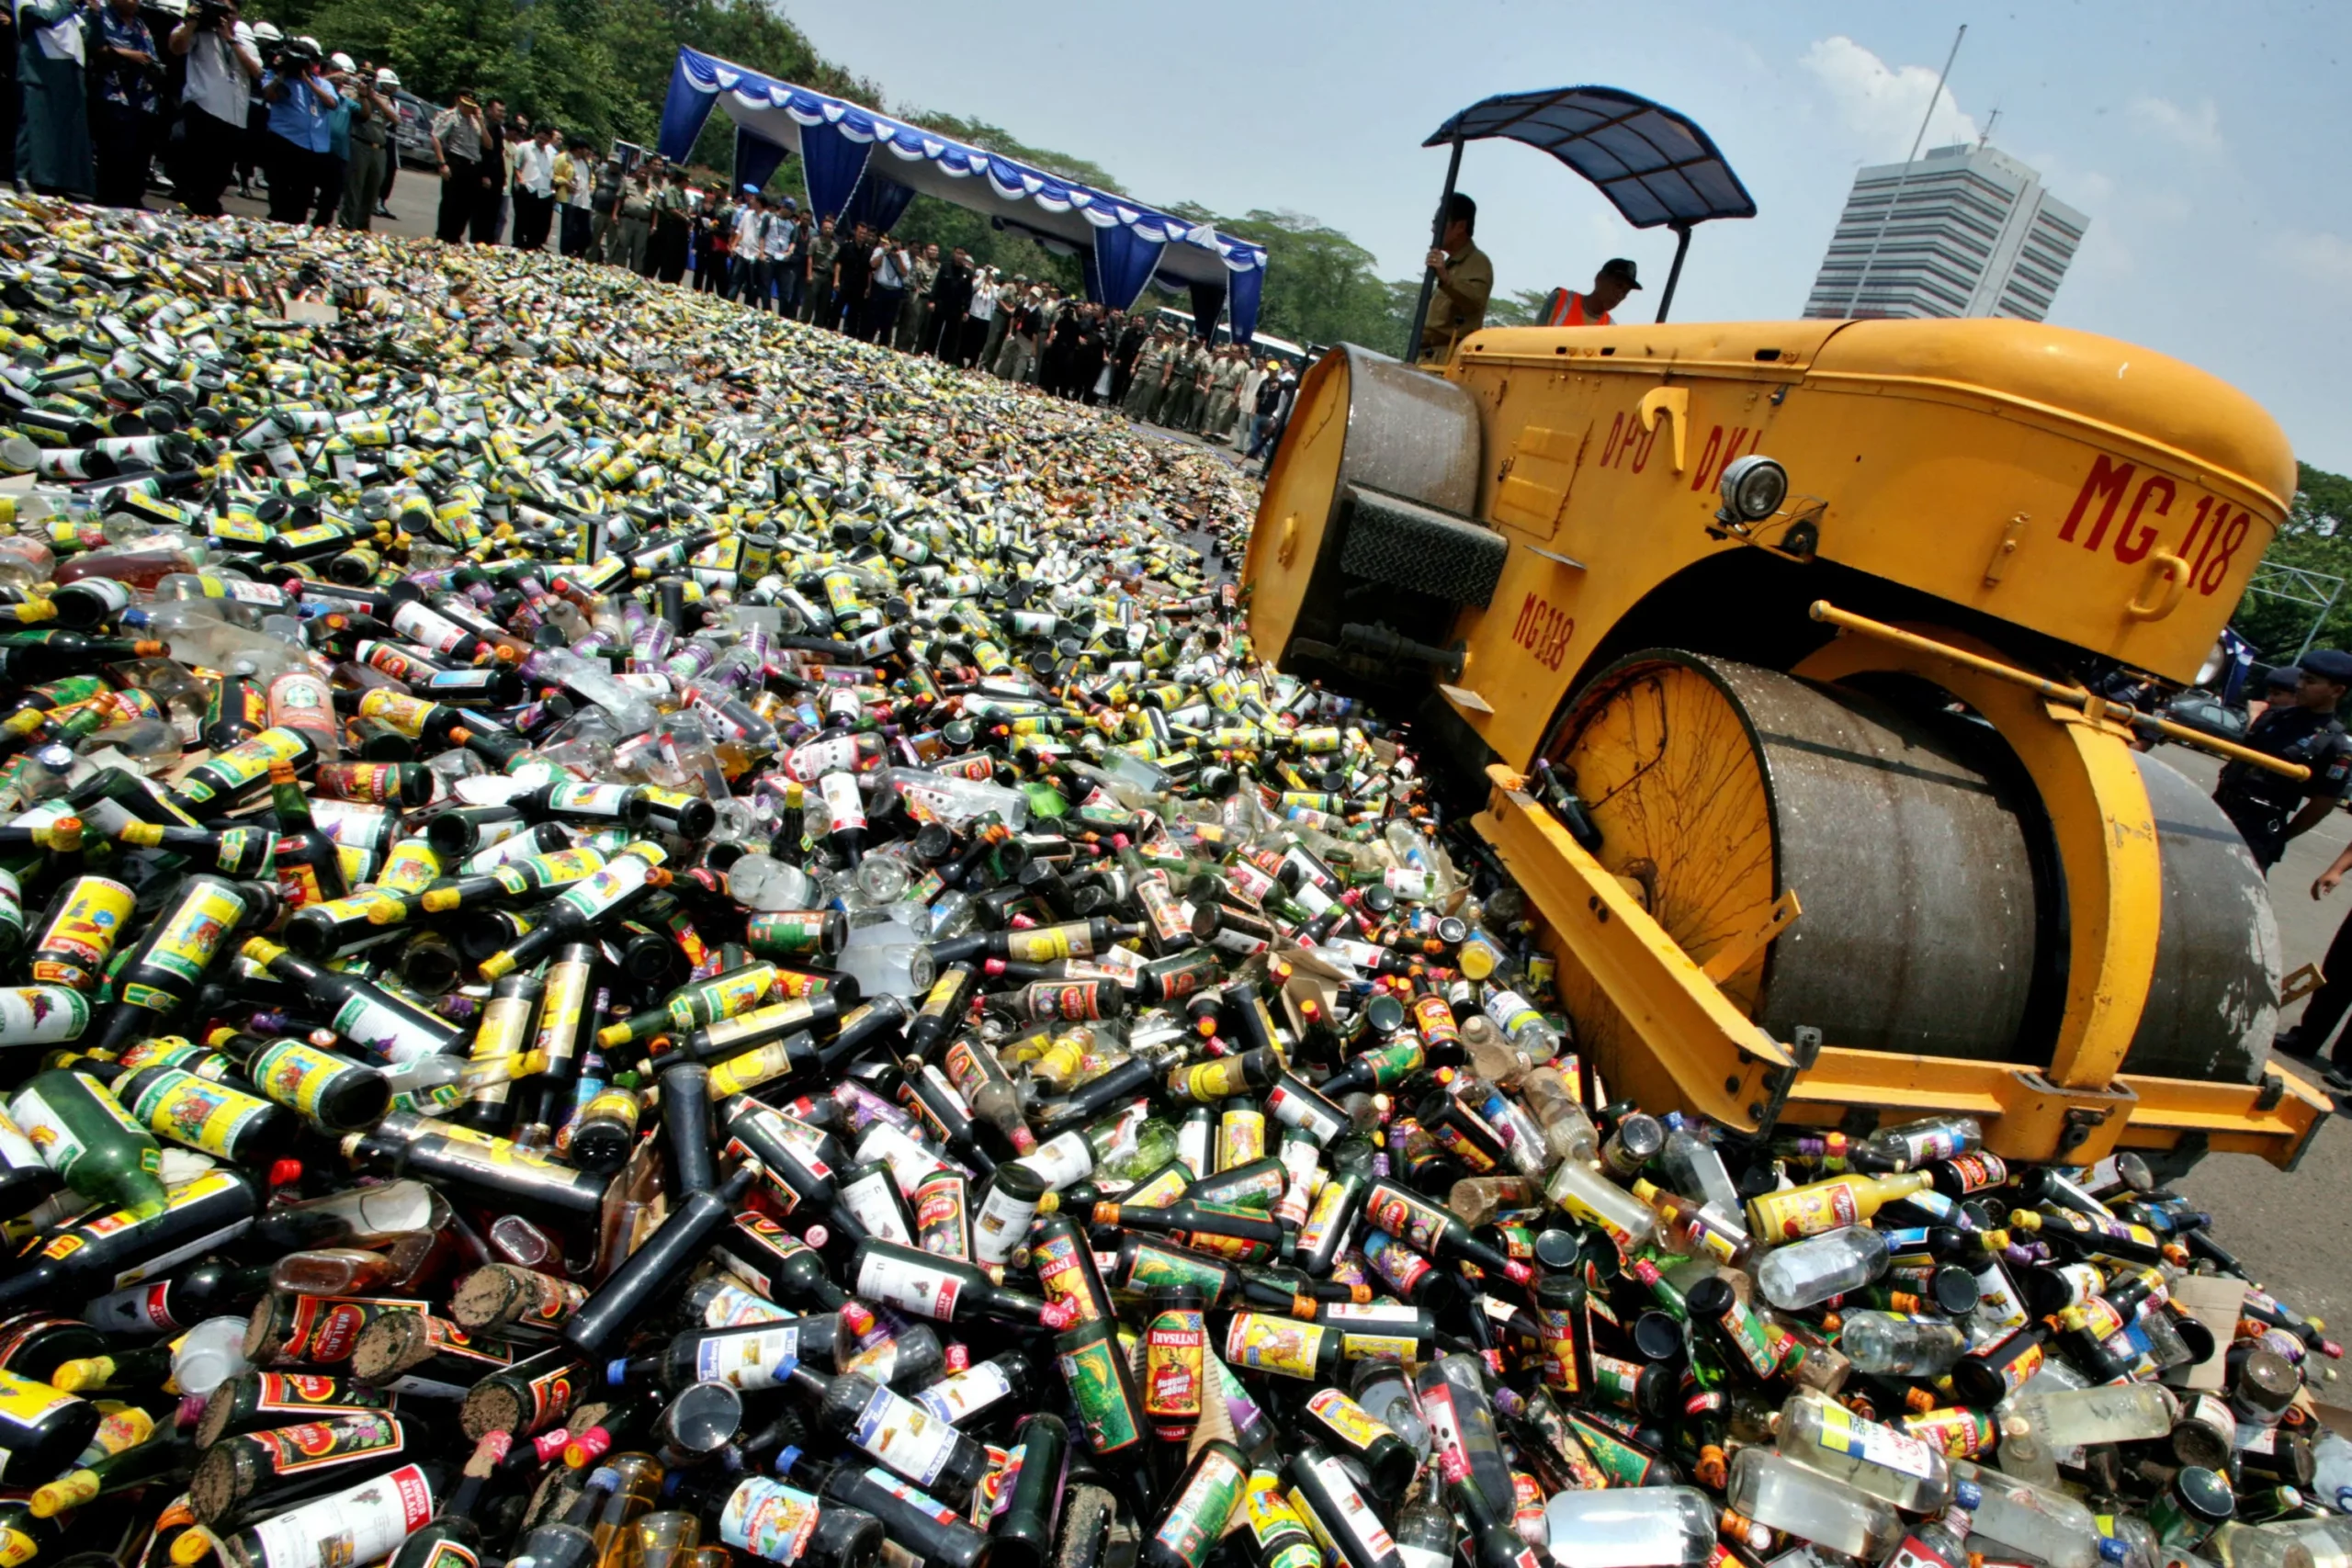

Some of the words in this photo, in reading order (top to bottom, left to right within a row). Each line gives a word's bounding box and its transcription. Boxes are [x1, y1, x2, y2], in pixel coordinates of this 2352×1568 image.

[2057, 454, 2177, 565] MG
[2164, 494, 2251, 596] 118
[321, 1310, 349, 1357] MALAGA
[1152, 1331, 1198, 1344] INTISARI
[398, 1478, 416, 1525] MALAGA
[410, 1477, 428, 1516] ANGGUR
